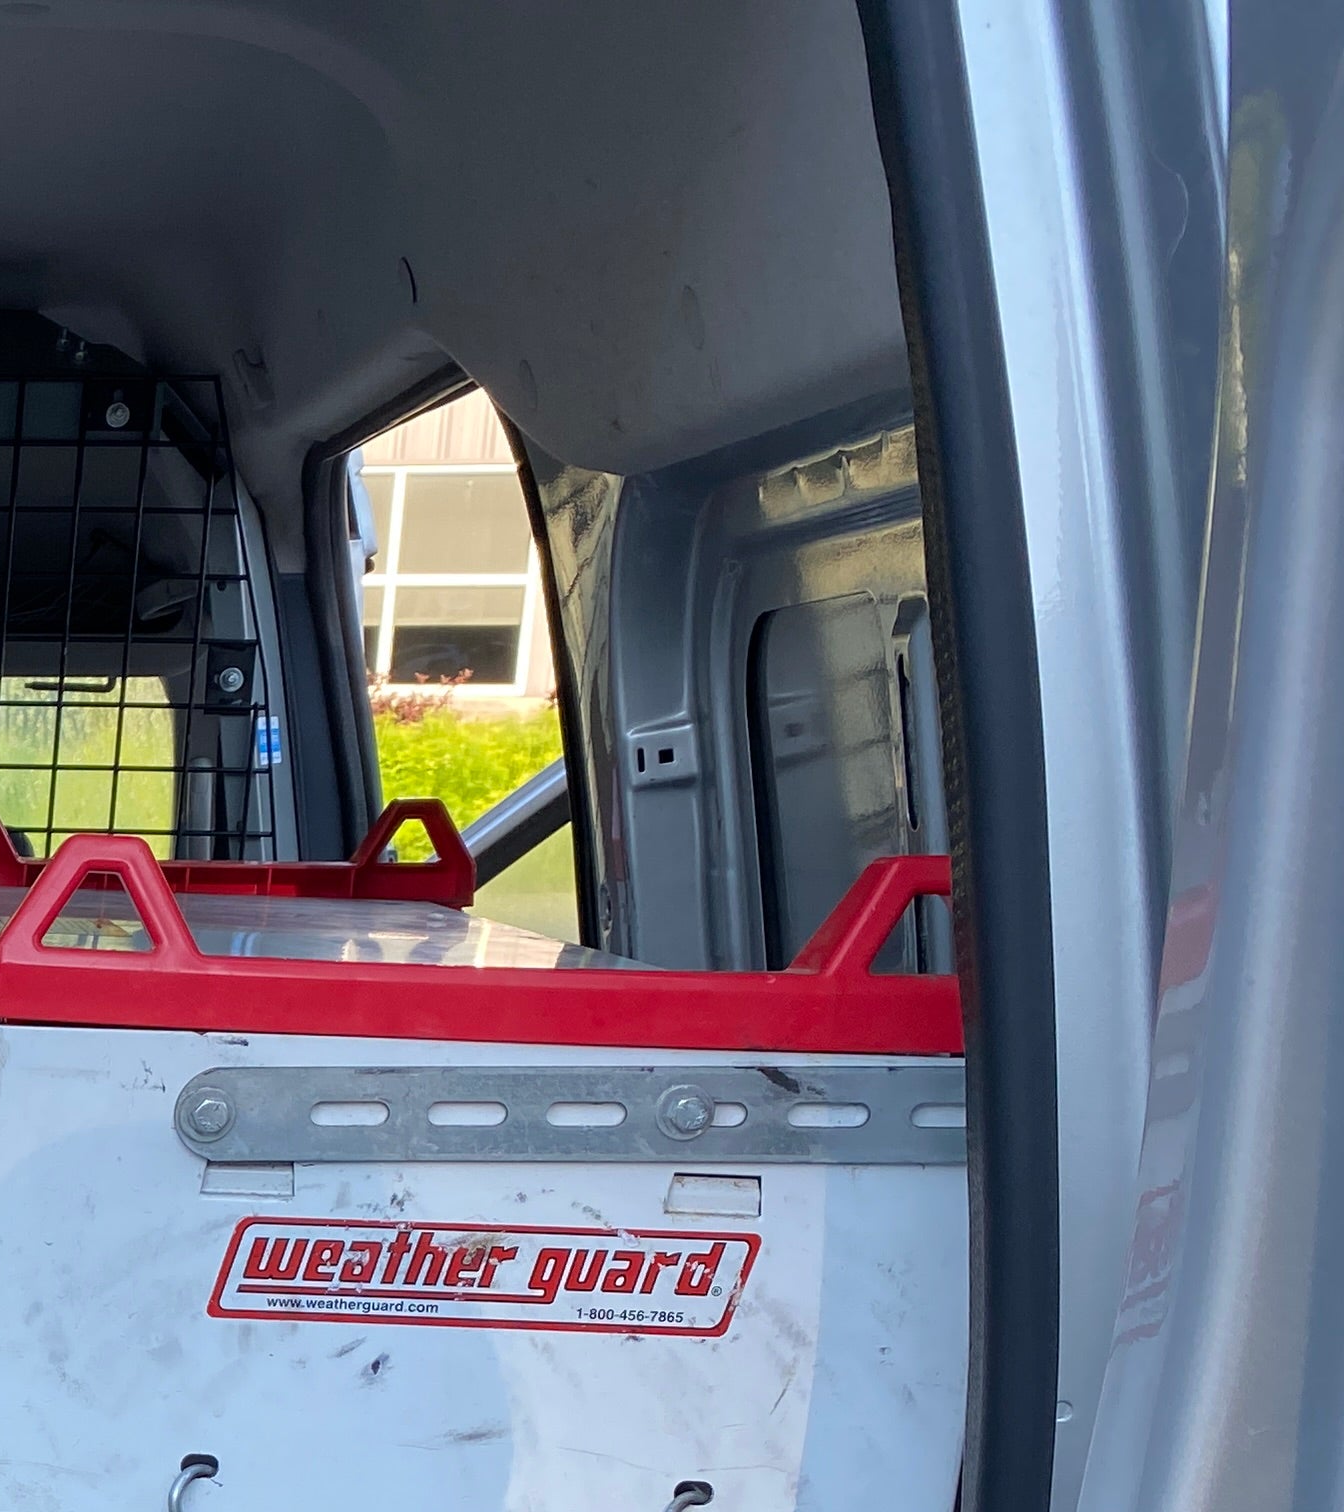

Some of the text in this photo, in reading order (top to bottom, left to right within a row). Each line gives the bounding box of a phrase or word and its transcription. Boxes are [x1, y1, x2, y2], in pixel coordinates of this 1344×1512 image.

[242, 1231, 725, 1305] weather guard
[266, 1295, 440, 1315] www.weatherguard.com
[575, 1307, 684, 1325] 1-800-456-7865
